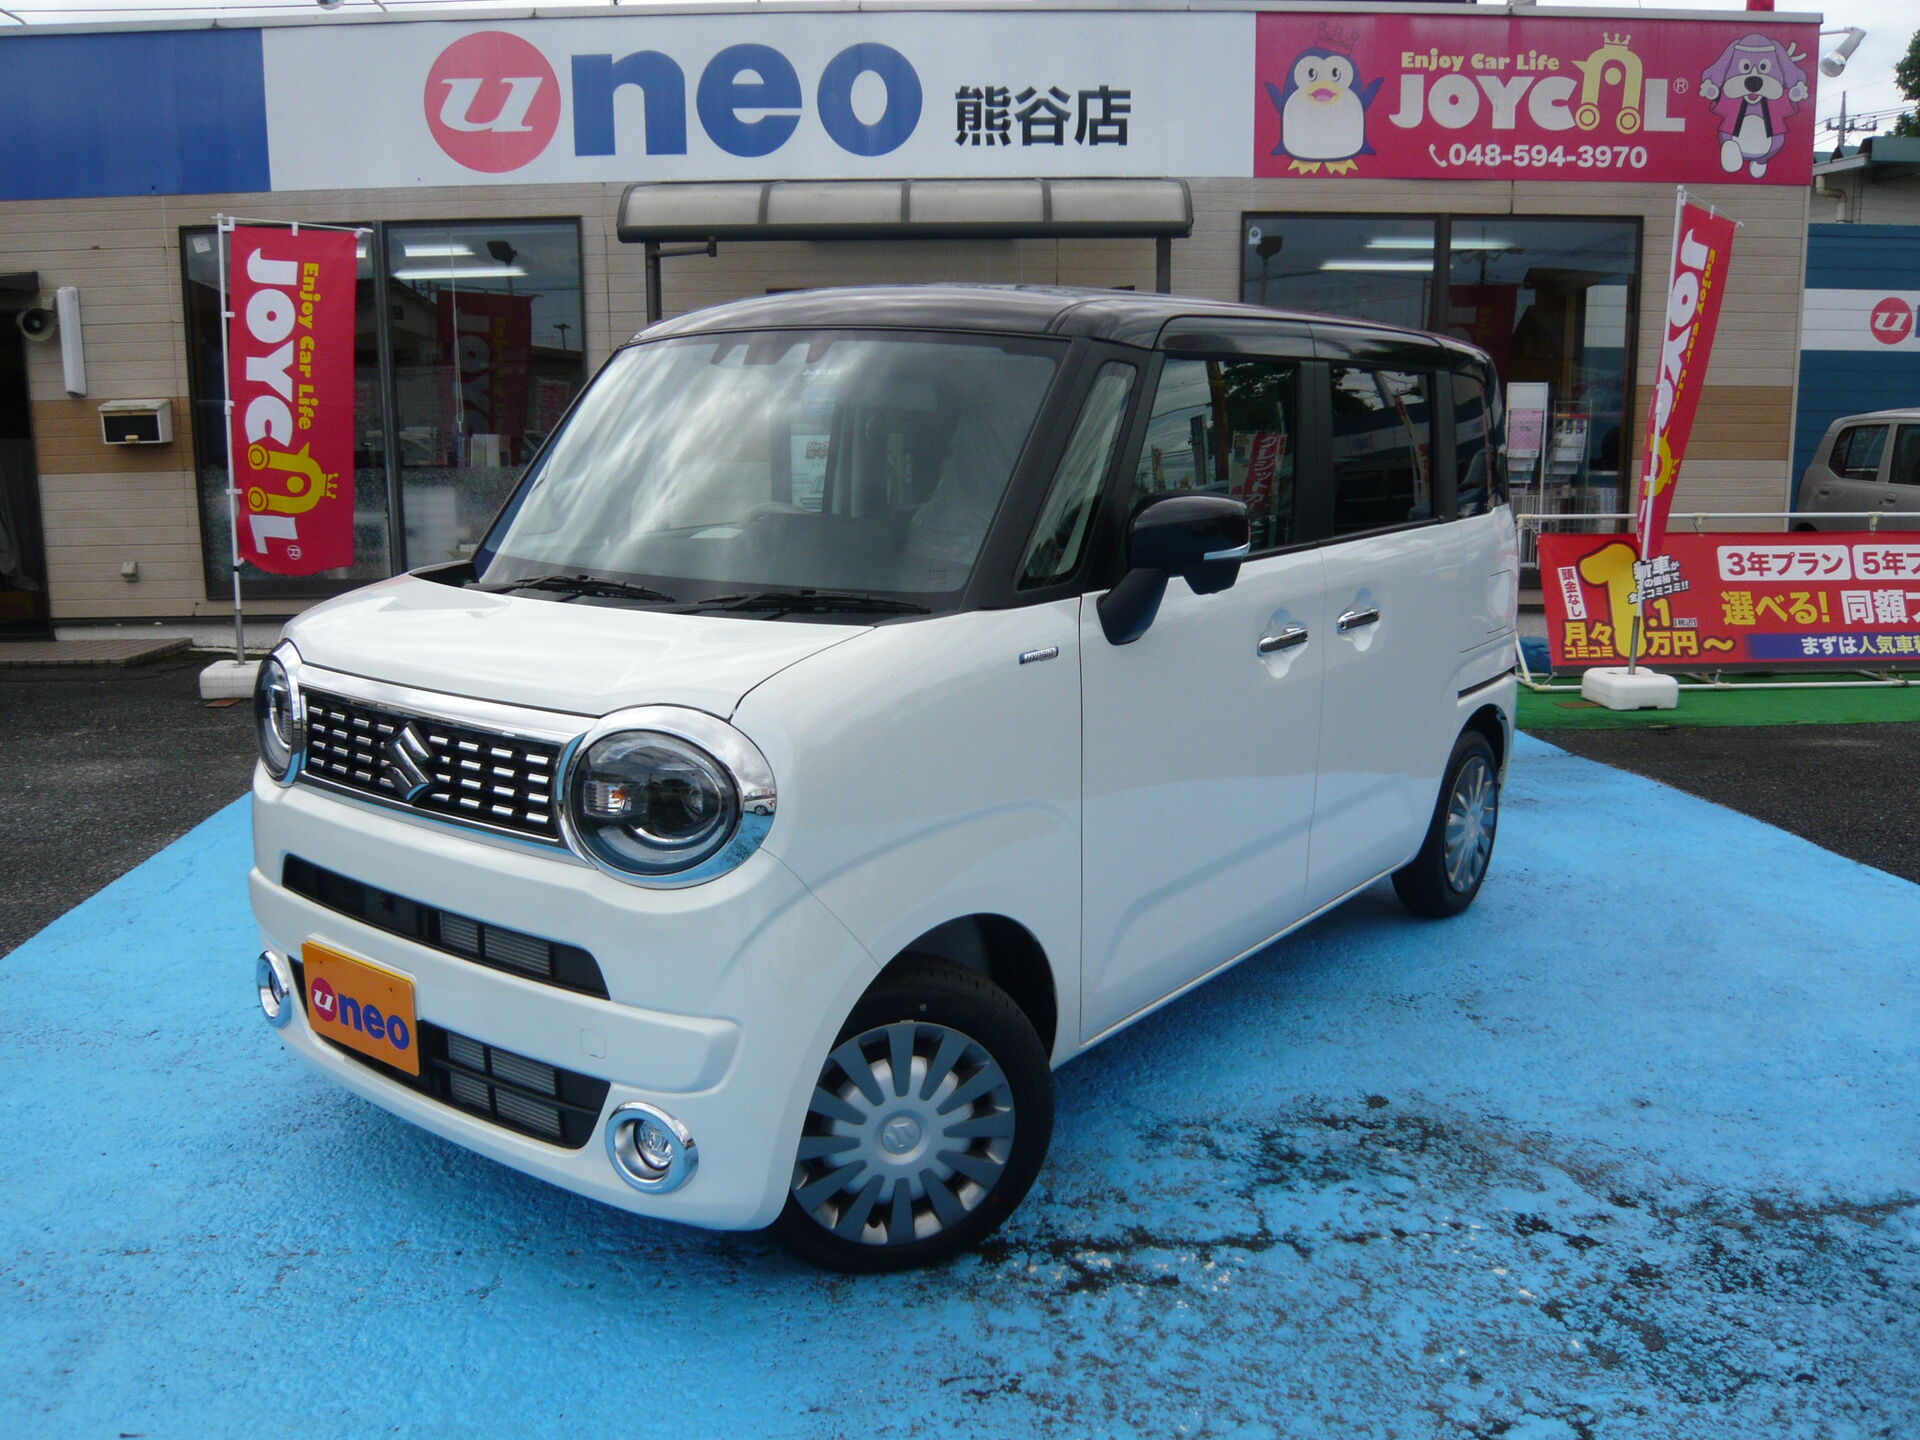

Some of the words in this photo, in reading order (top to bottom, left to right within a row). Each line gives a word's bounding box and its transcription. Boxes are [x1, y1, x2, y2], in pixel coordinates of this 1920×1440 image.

[1401, 48, 1464, 72] Enjoy
[1471, 53, 1510, 70] Car
[1517, 50, 1560, 71] Life
[955, 85, 1131, 146] 熊谷店
[1449, 143, 1647, 168] 048-594-3970
[300, 262, 320, 329] Enjoy
[1696, 248, 1716, 317] Enjoy
[300, 335, 315, 378] Car
[298, 384, 319, 430] Life
[1726, 552, 1843, 576] 3年プラン
[1561, 568, 1582, 618] 頭金なし
[1721, 591, 1830, 625] 選べる!
[1564, 622, 1613, 647] 月々
[1564, 646, 1615, 659] コミコミ
